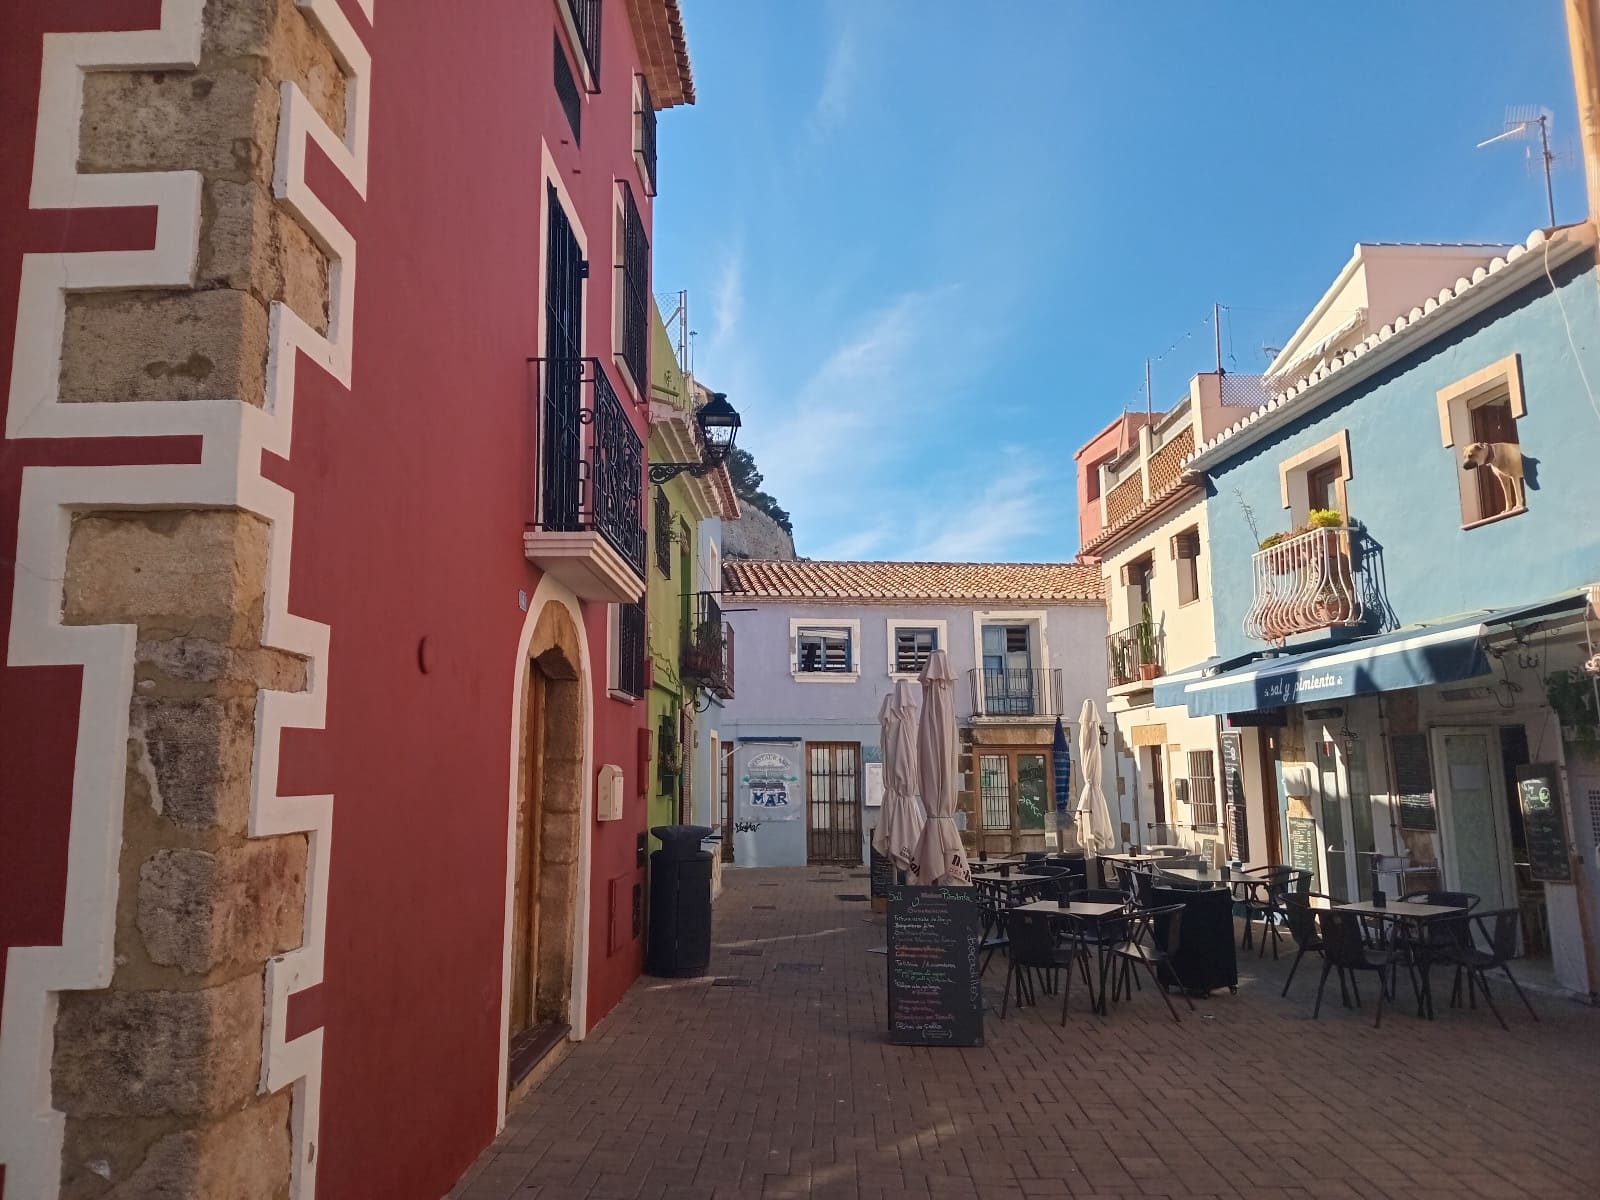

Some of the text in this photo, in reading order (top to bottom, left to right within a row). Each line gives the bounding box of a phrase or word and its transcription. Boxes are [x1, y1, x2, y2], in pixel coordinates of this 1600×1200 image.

[1271, 673, 1336, 702] sal y pimienta
[752, 791, 787, 806] MAR
